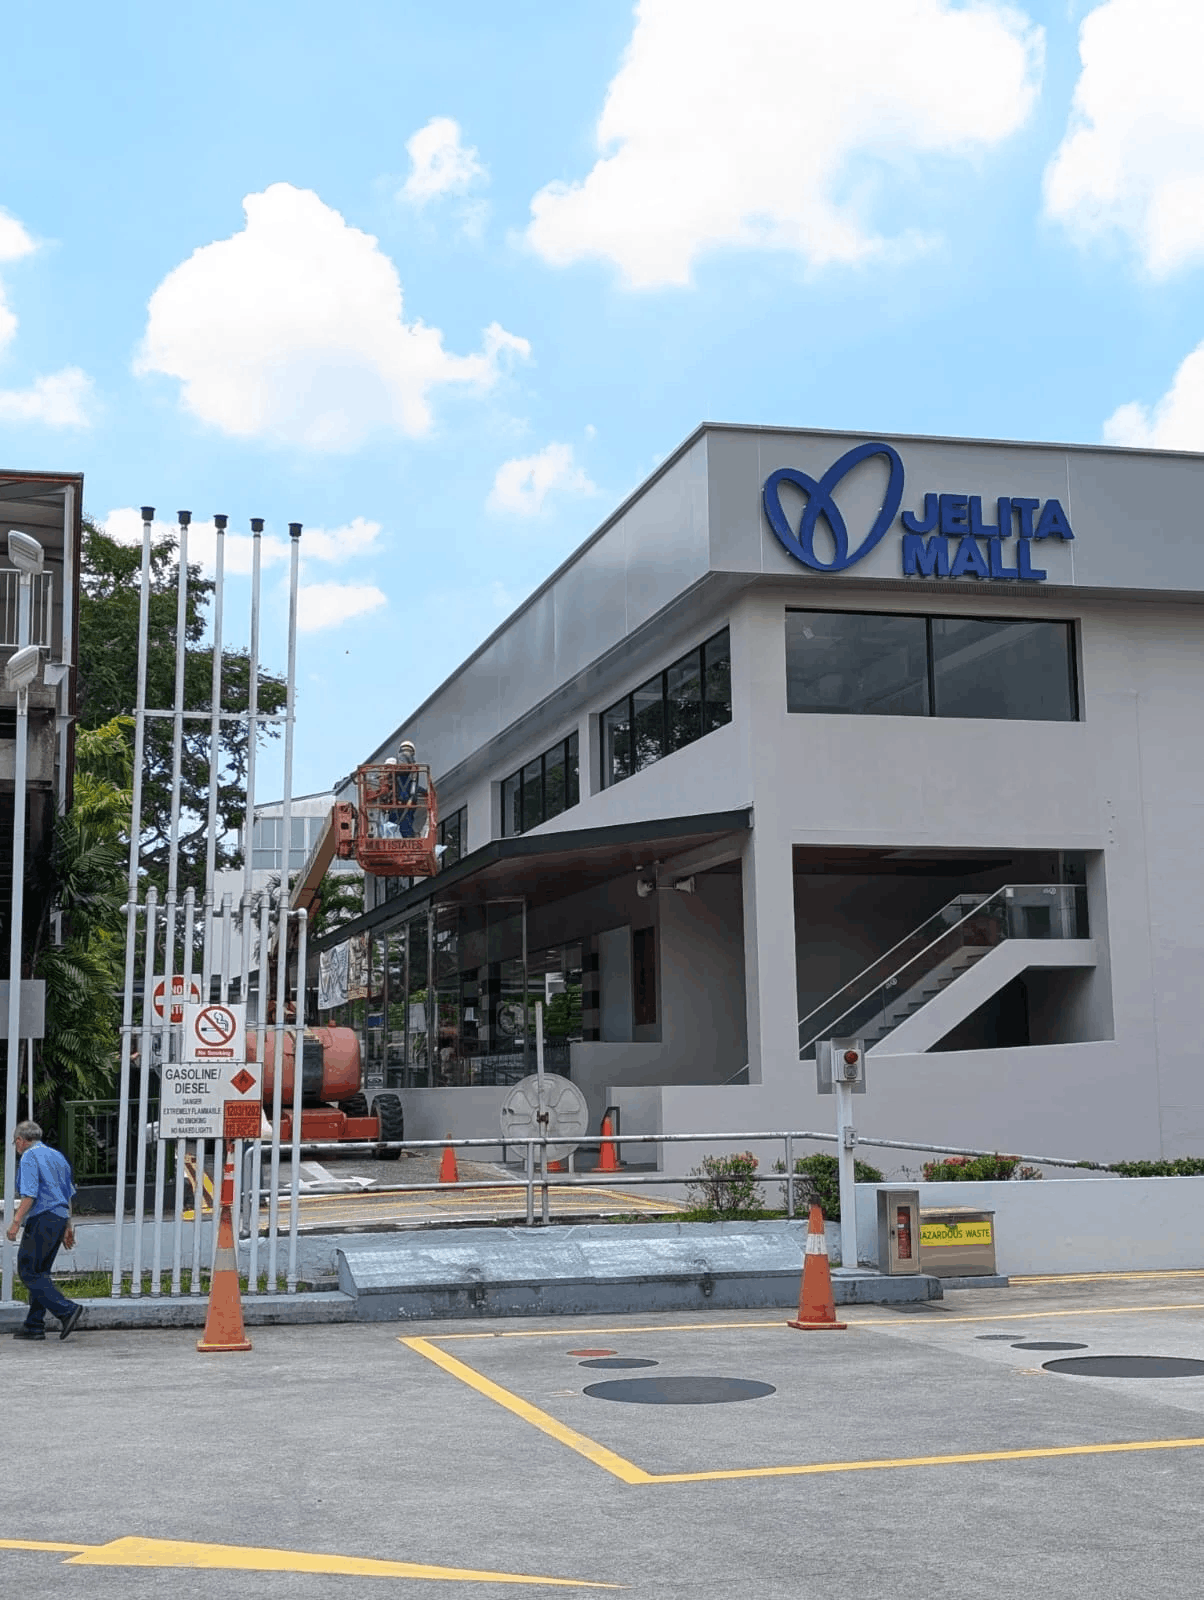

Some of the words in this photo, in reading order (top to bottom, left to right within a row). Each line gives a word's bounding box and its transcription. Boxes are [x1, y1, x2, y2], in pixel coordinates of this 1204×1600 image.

[901, 493, 1075, 540] JELITA
[902, 534, 1047, 580] MALL
[165, 1068, 222, 1080] GASOLINE/
[175, 1082, 211, 1094] DIESEL
[965, 1228, 990, 1238] WASTE
